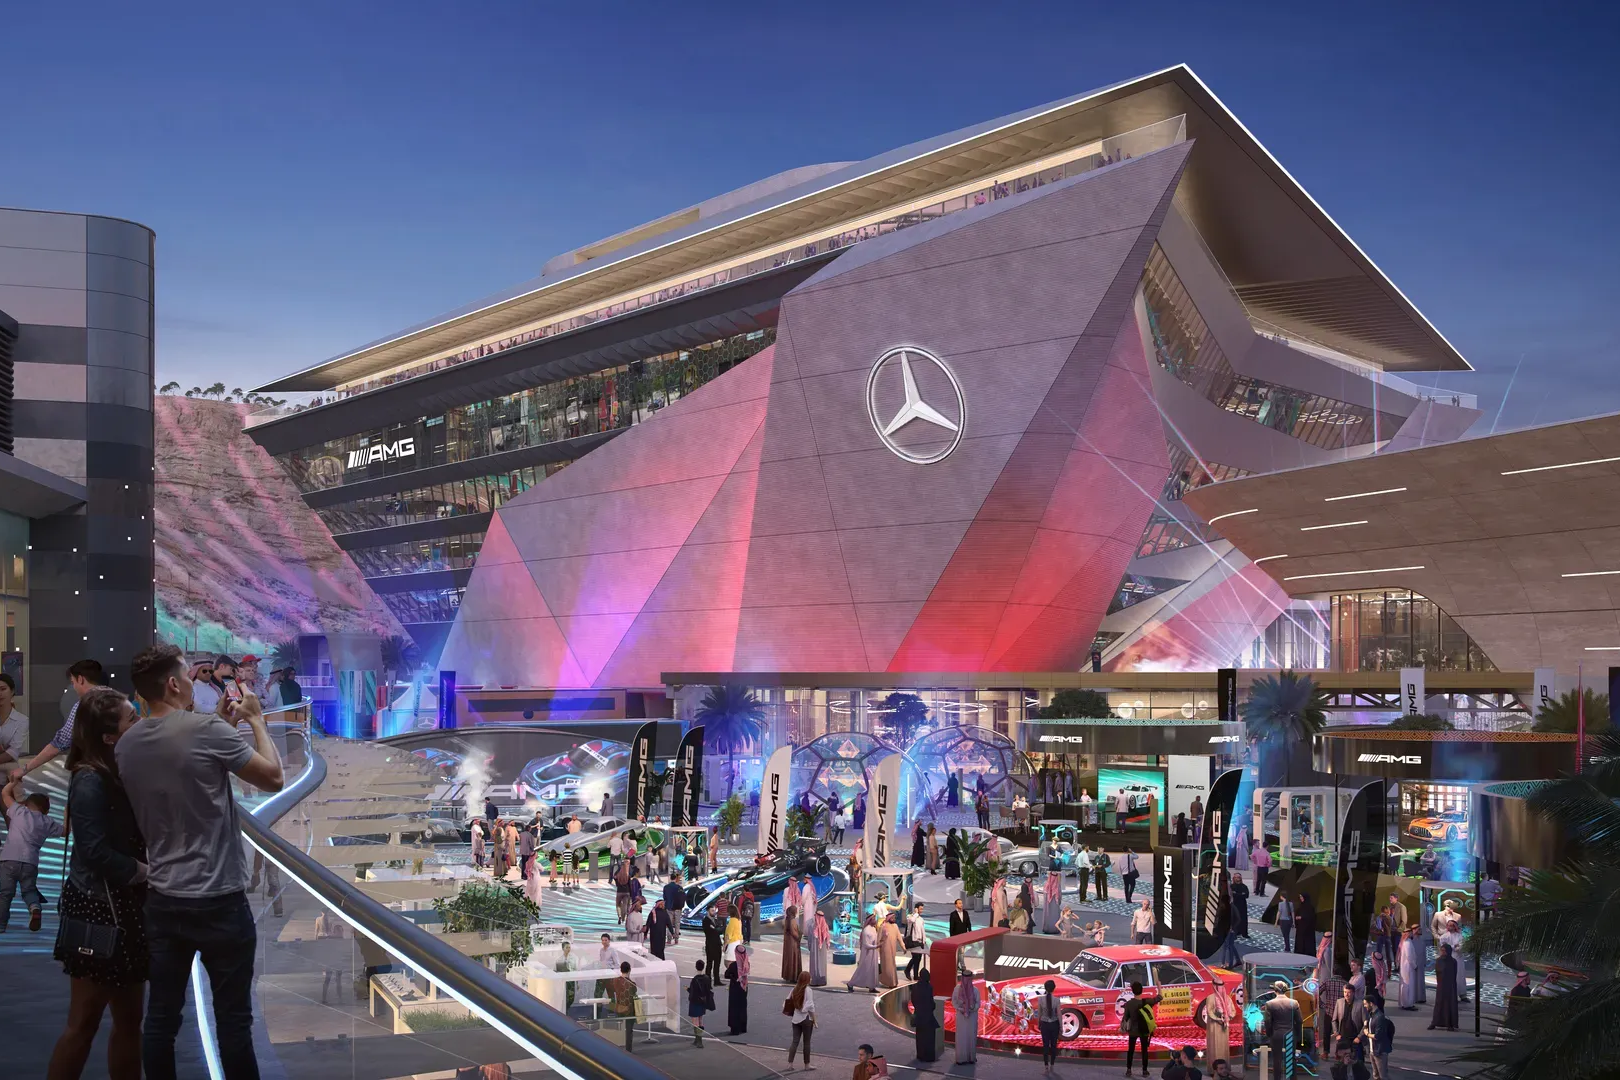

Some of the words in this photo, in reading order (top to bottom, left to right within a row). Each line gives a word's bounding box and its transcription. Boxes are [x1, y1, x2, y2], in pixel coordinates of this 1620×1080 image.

[367, 437, 415, 464] AMG
[637, 738, 648, 805] AMG
[683, 745, 694, 814] AMG
[1376, 754, 1422, 765] AMG
[770, 773, 780, 843] AMG
[876, 783, 887, 862] AMG
[1163, 855, 1172, 905] AMG
[1209, 811, 1222, 895] AMG
[1344, 831, 1360, 927] AMG
